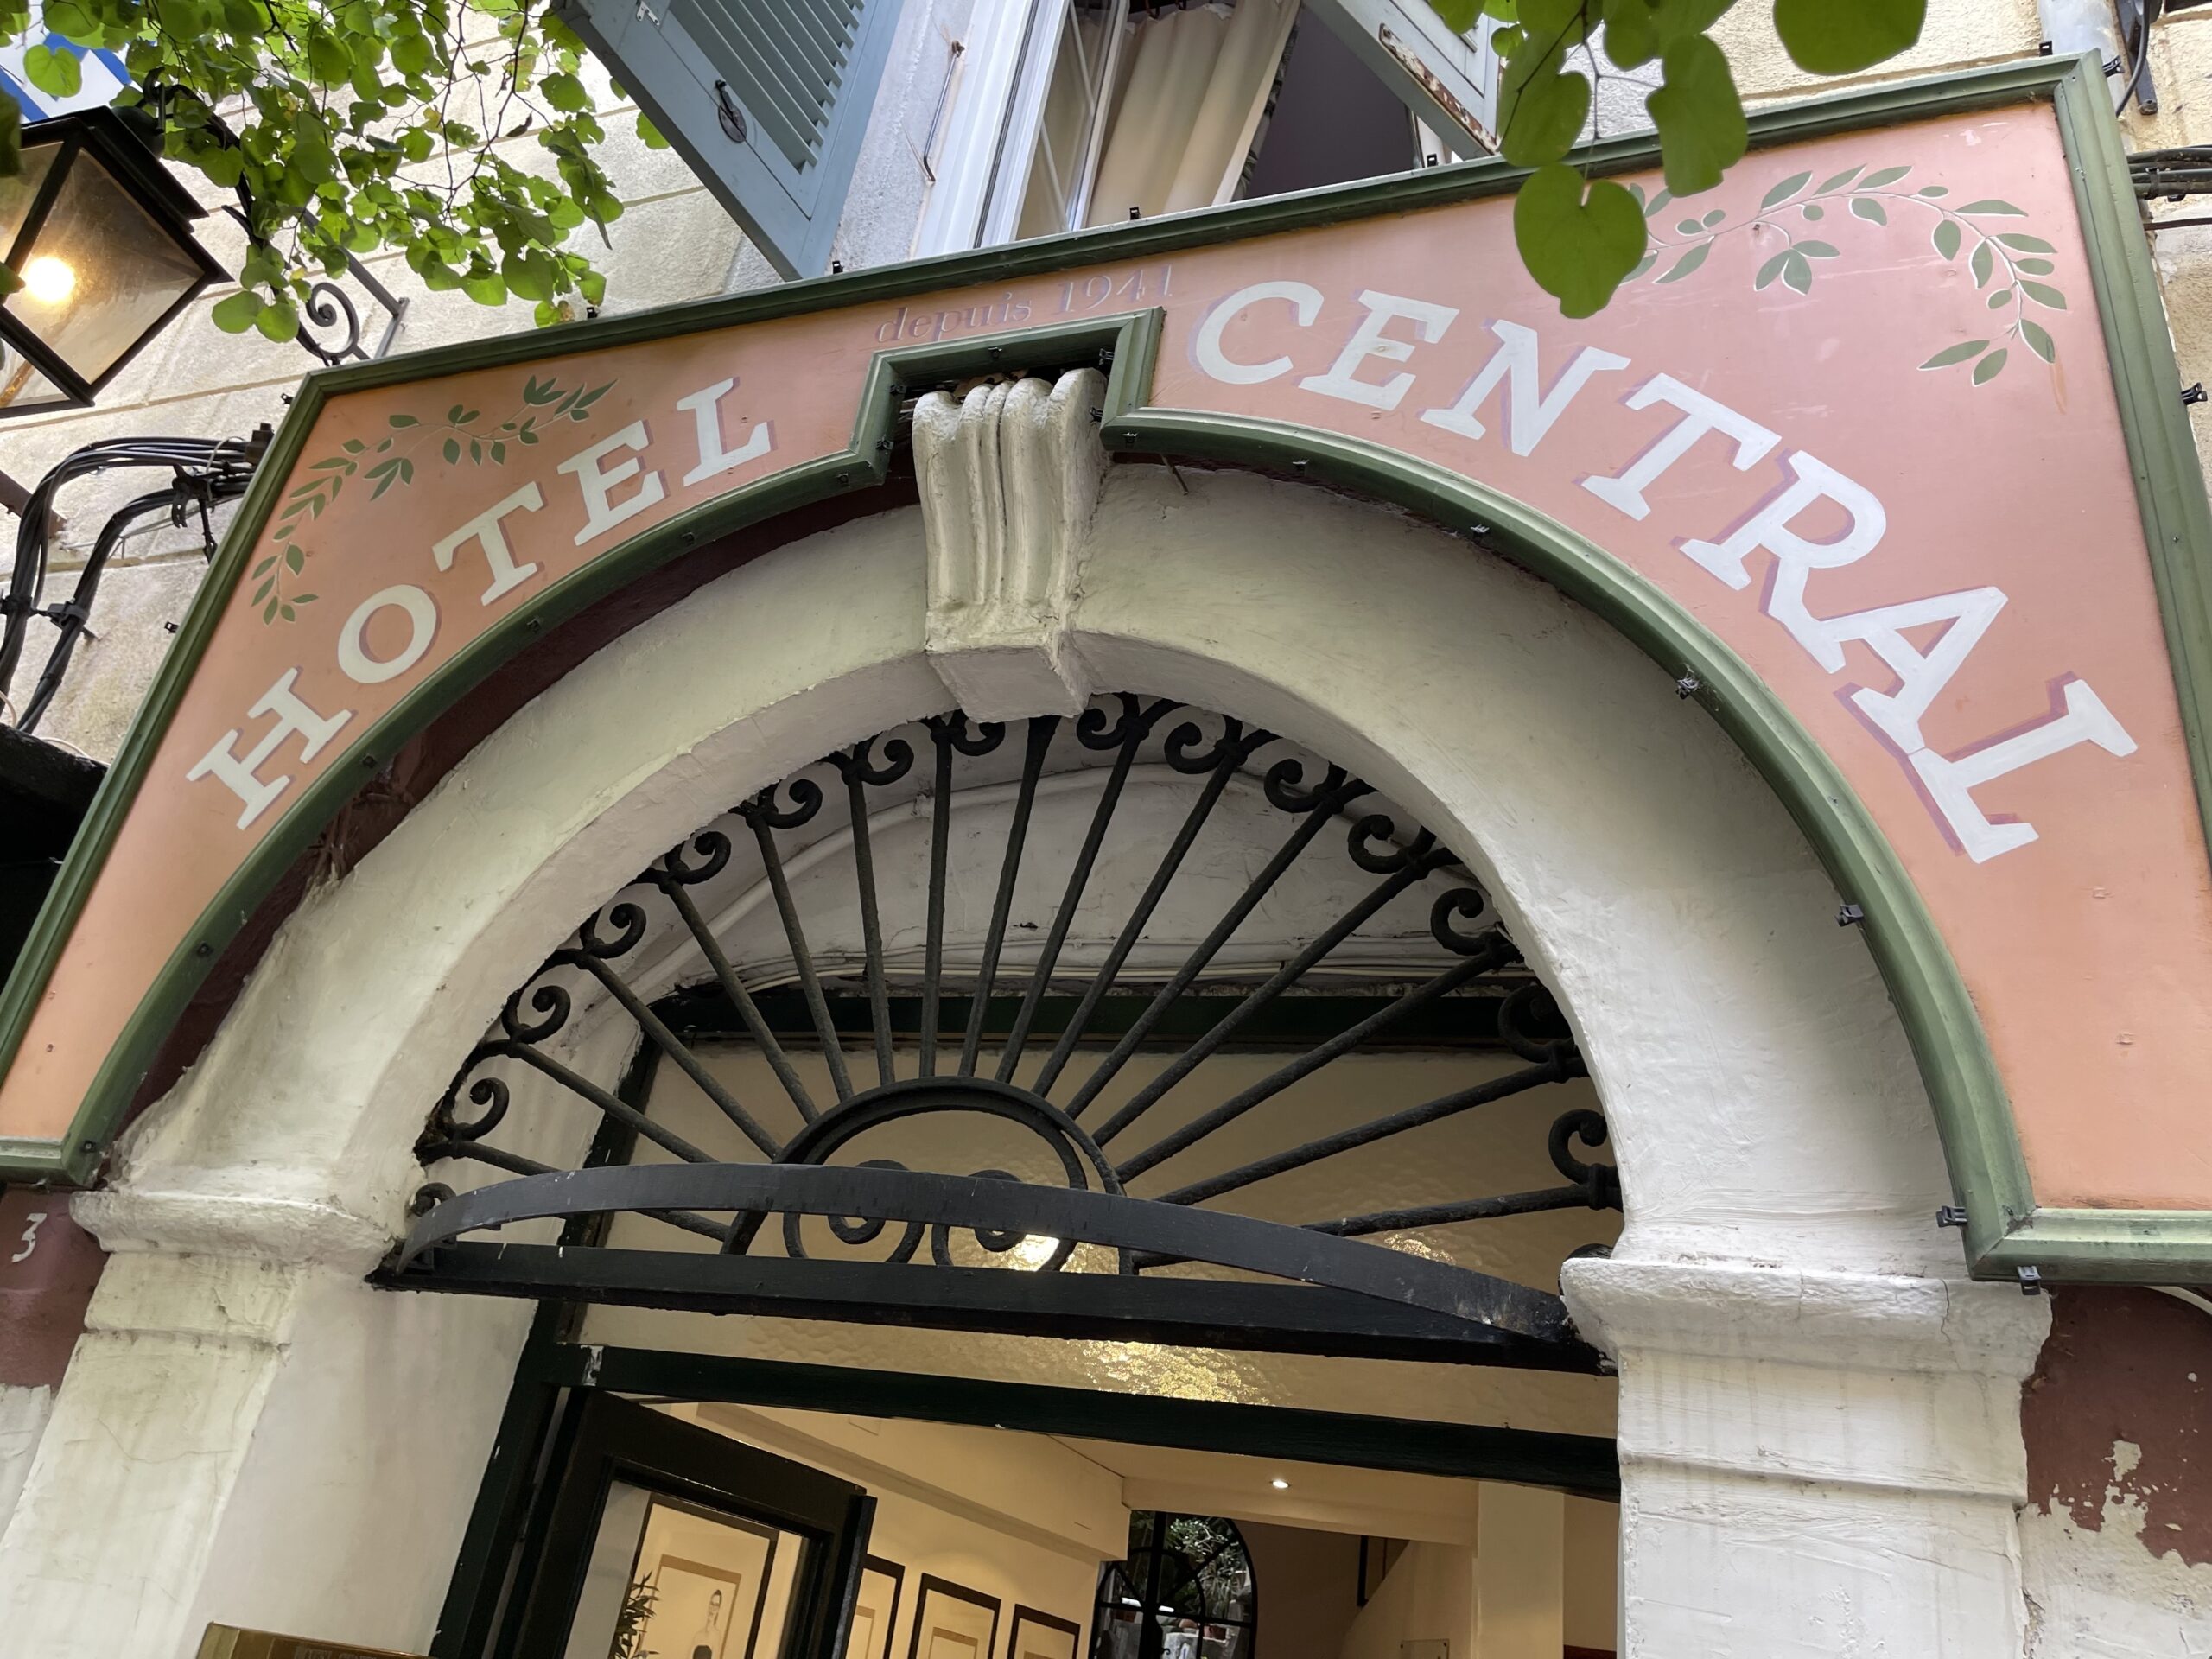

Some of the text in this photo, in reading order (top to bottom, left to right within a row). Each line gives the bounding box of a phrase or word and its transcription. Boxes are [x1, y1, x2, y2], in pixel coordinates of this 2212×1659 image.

[875, 264, 1173, 342] depuis 1941
[185, 280, 2138, 864] HOTEL CENTRAL
